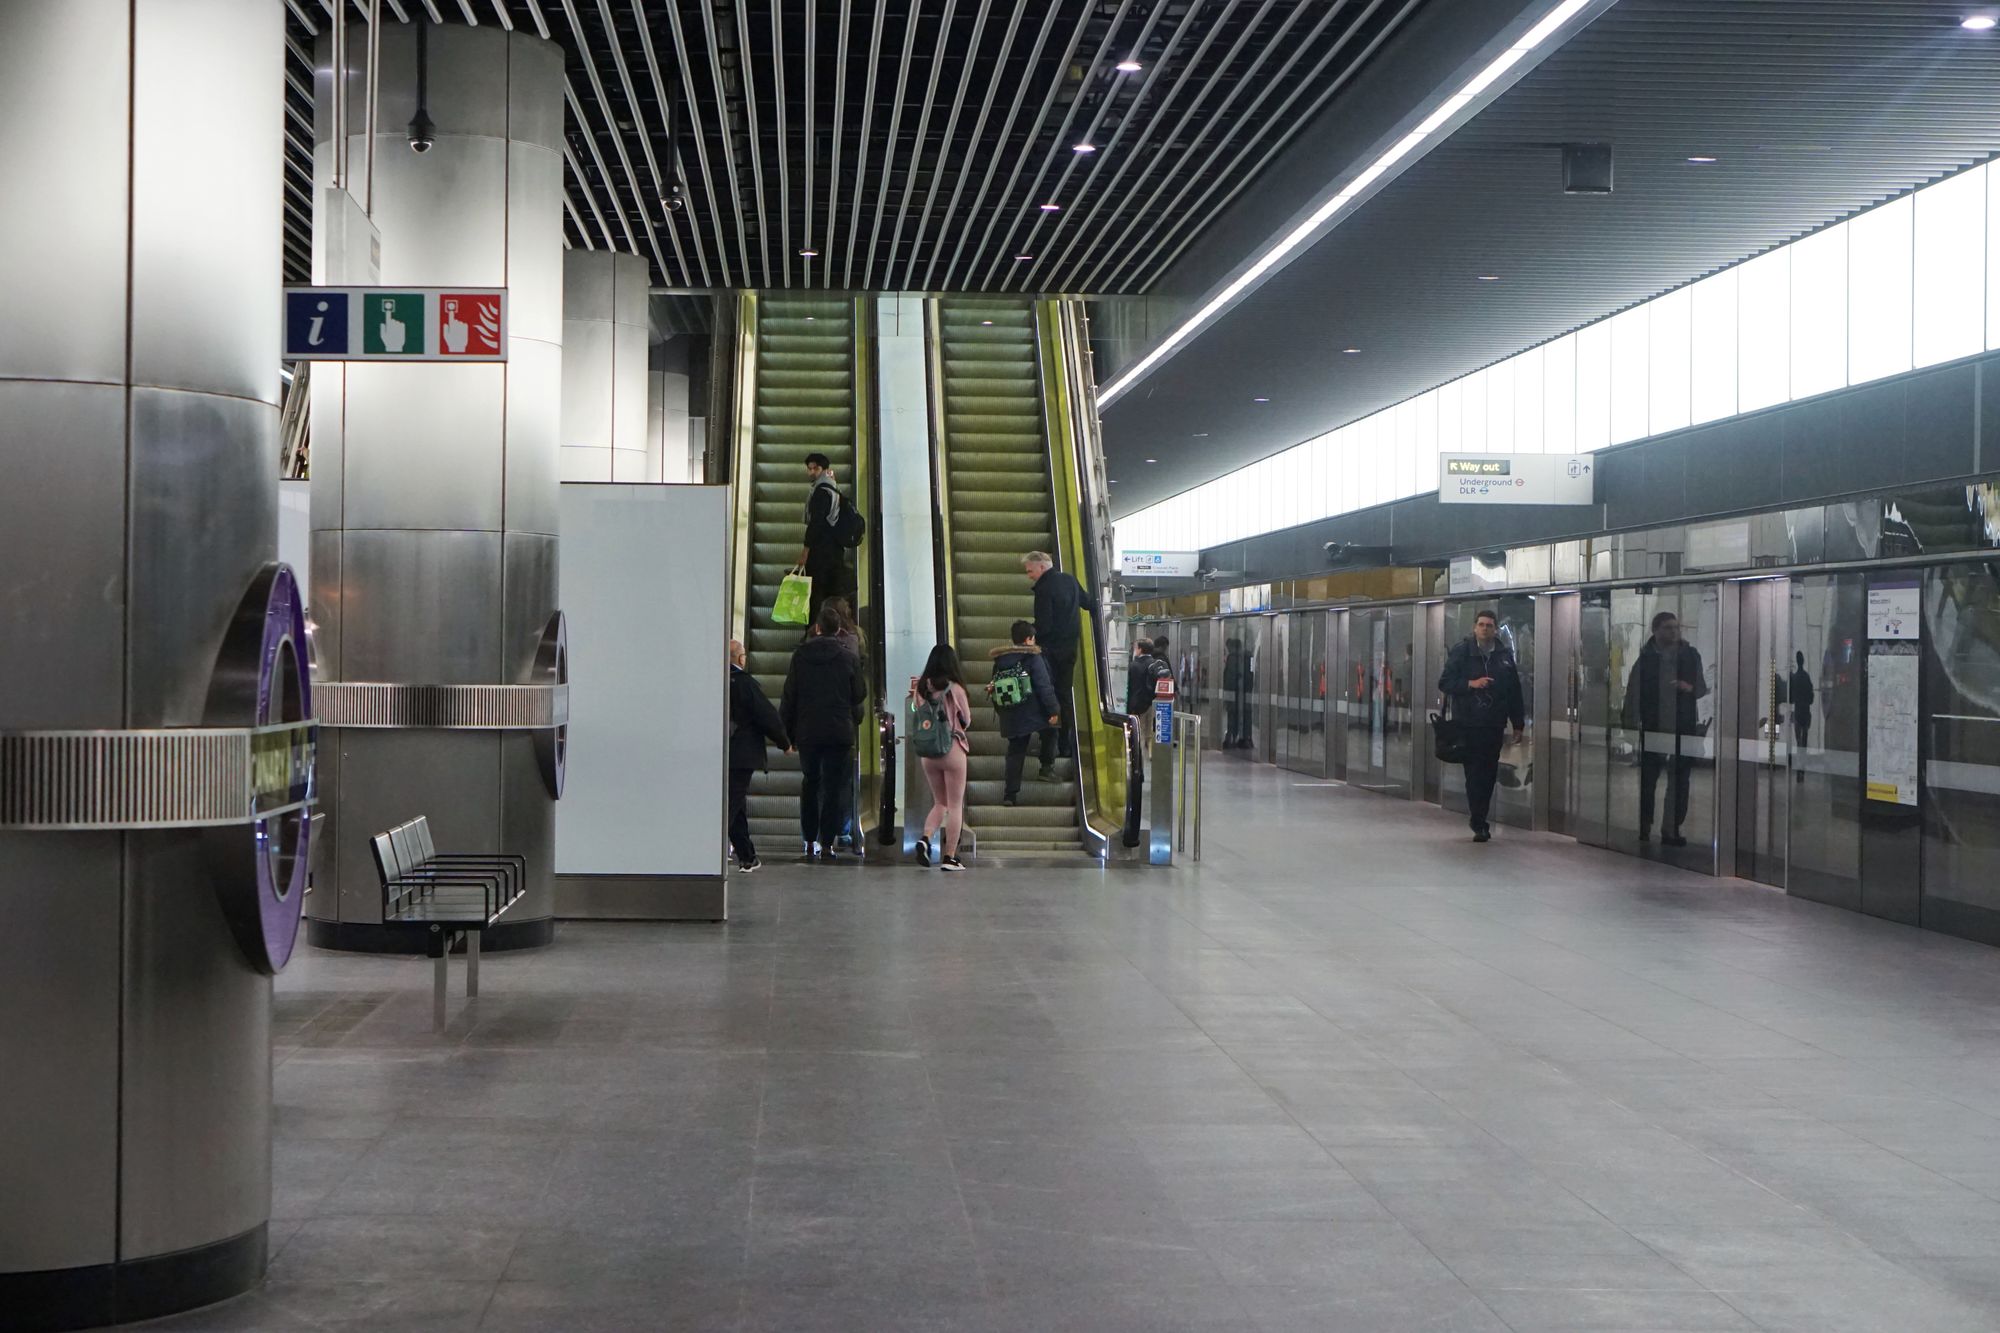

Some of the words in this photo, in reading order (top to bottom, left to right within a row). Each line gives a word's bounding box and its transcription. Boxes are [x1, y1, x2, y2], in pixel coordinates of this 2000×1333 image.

[1460, 462, 1480, 473] Way
[1483, 462, 1500, 471] out
[1460, 478, 1512, 486] Underground
